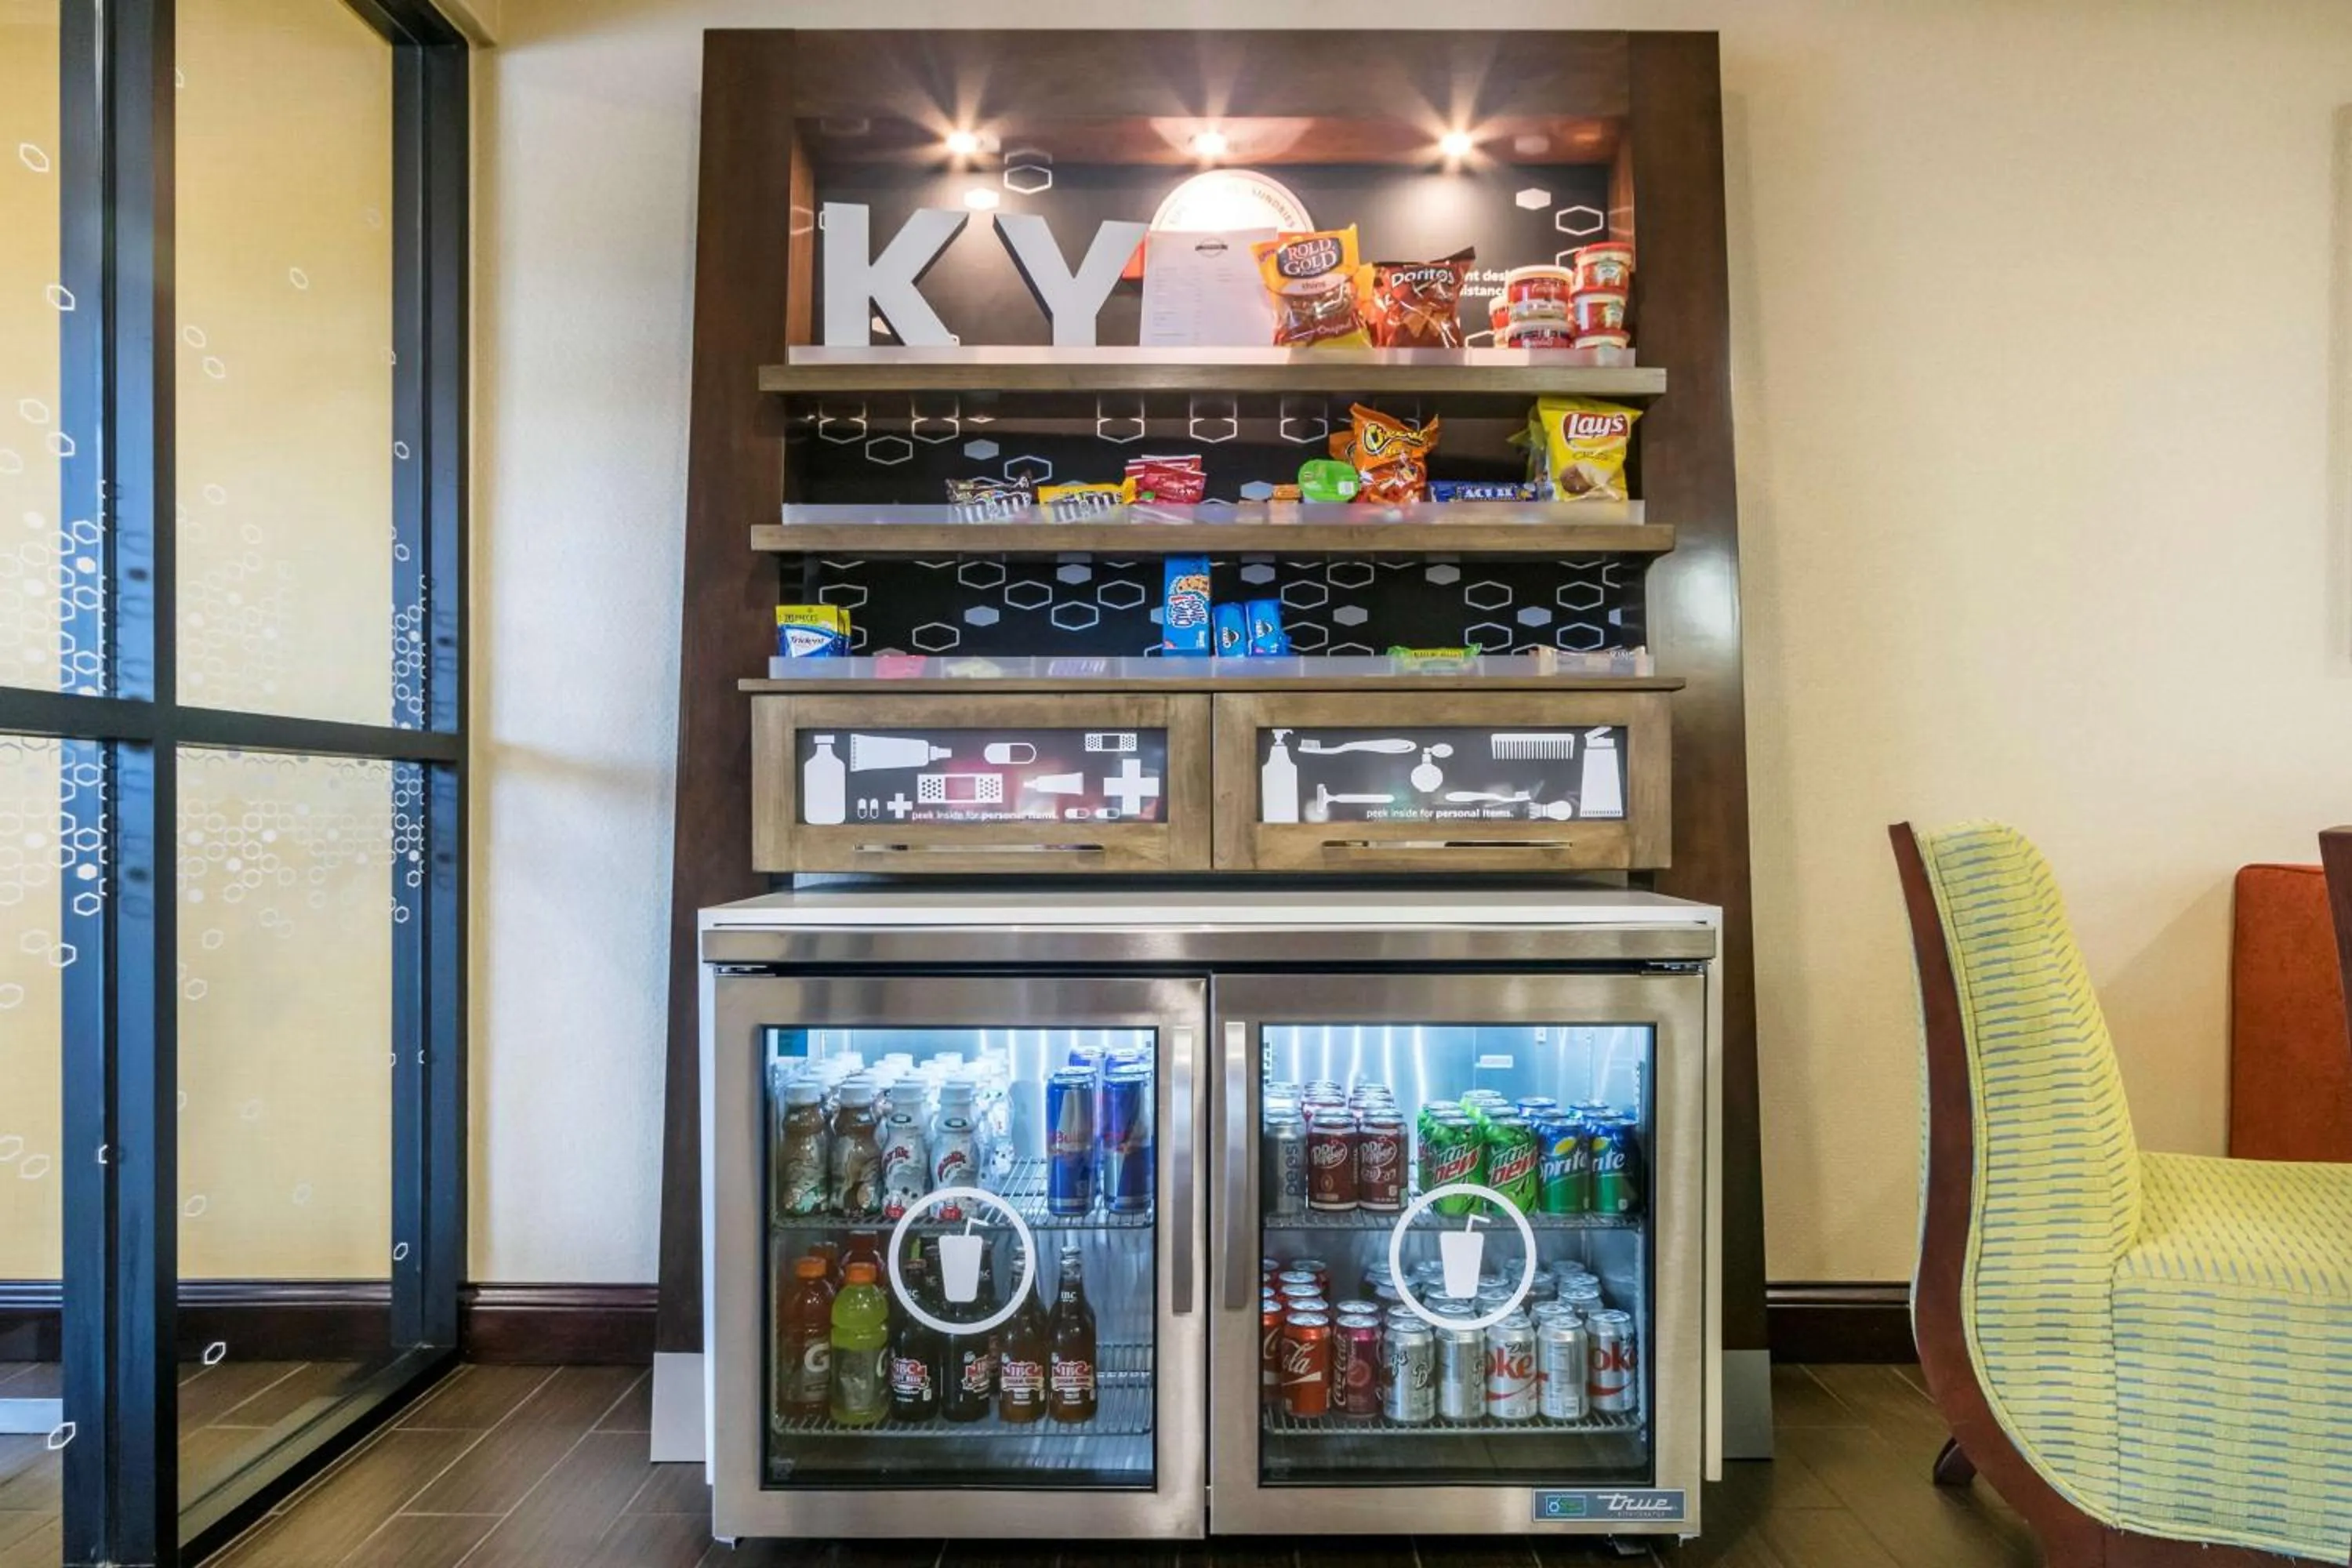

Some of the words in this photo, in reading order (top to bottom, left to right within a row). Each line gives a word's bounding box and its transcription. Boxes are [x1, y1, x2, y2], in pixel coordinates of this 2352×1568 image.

[1287, 238, 1332, 260] ROLD
[1283, 250, 1337, 274] GOLD
[1391, 268, 1455, 289] Doritos
[1567, 412, 1624, 439] Lay's
[1464, 488, 1489, 498] ACT
[790, 636, 825, 644] Trident
[1367, 809, 1388, 819] peek
[1392, 809, 1417, 818] inside
[1420, 809, 1433, 818] for
[1436, 809, 1479, 819] personal
[1284, 1140, 1301, 1196] pepsi
[804, 1342, 830, 1373] G
[1485, 1347, 1534, 1380] oke
